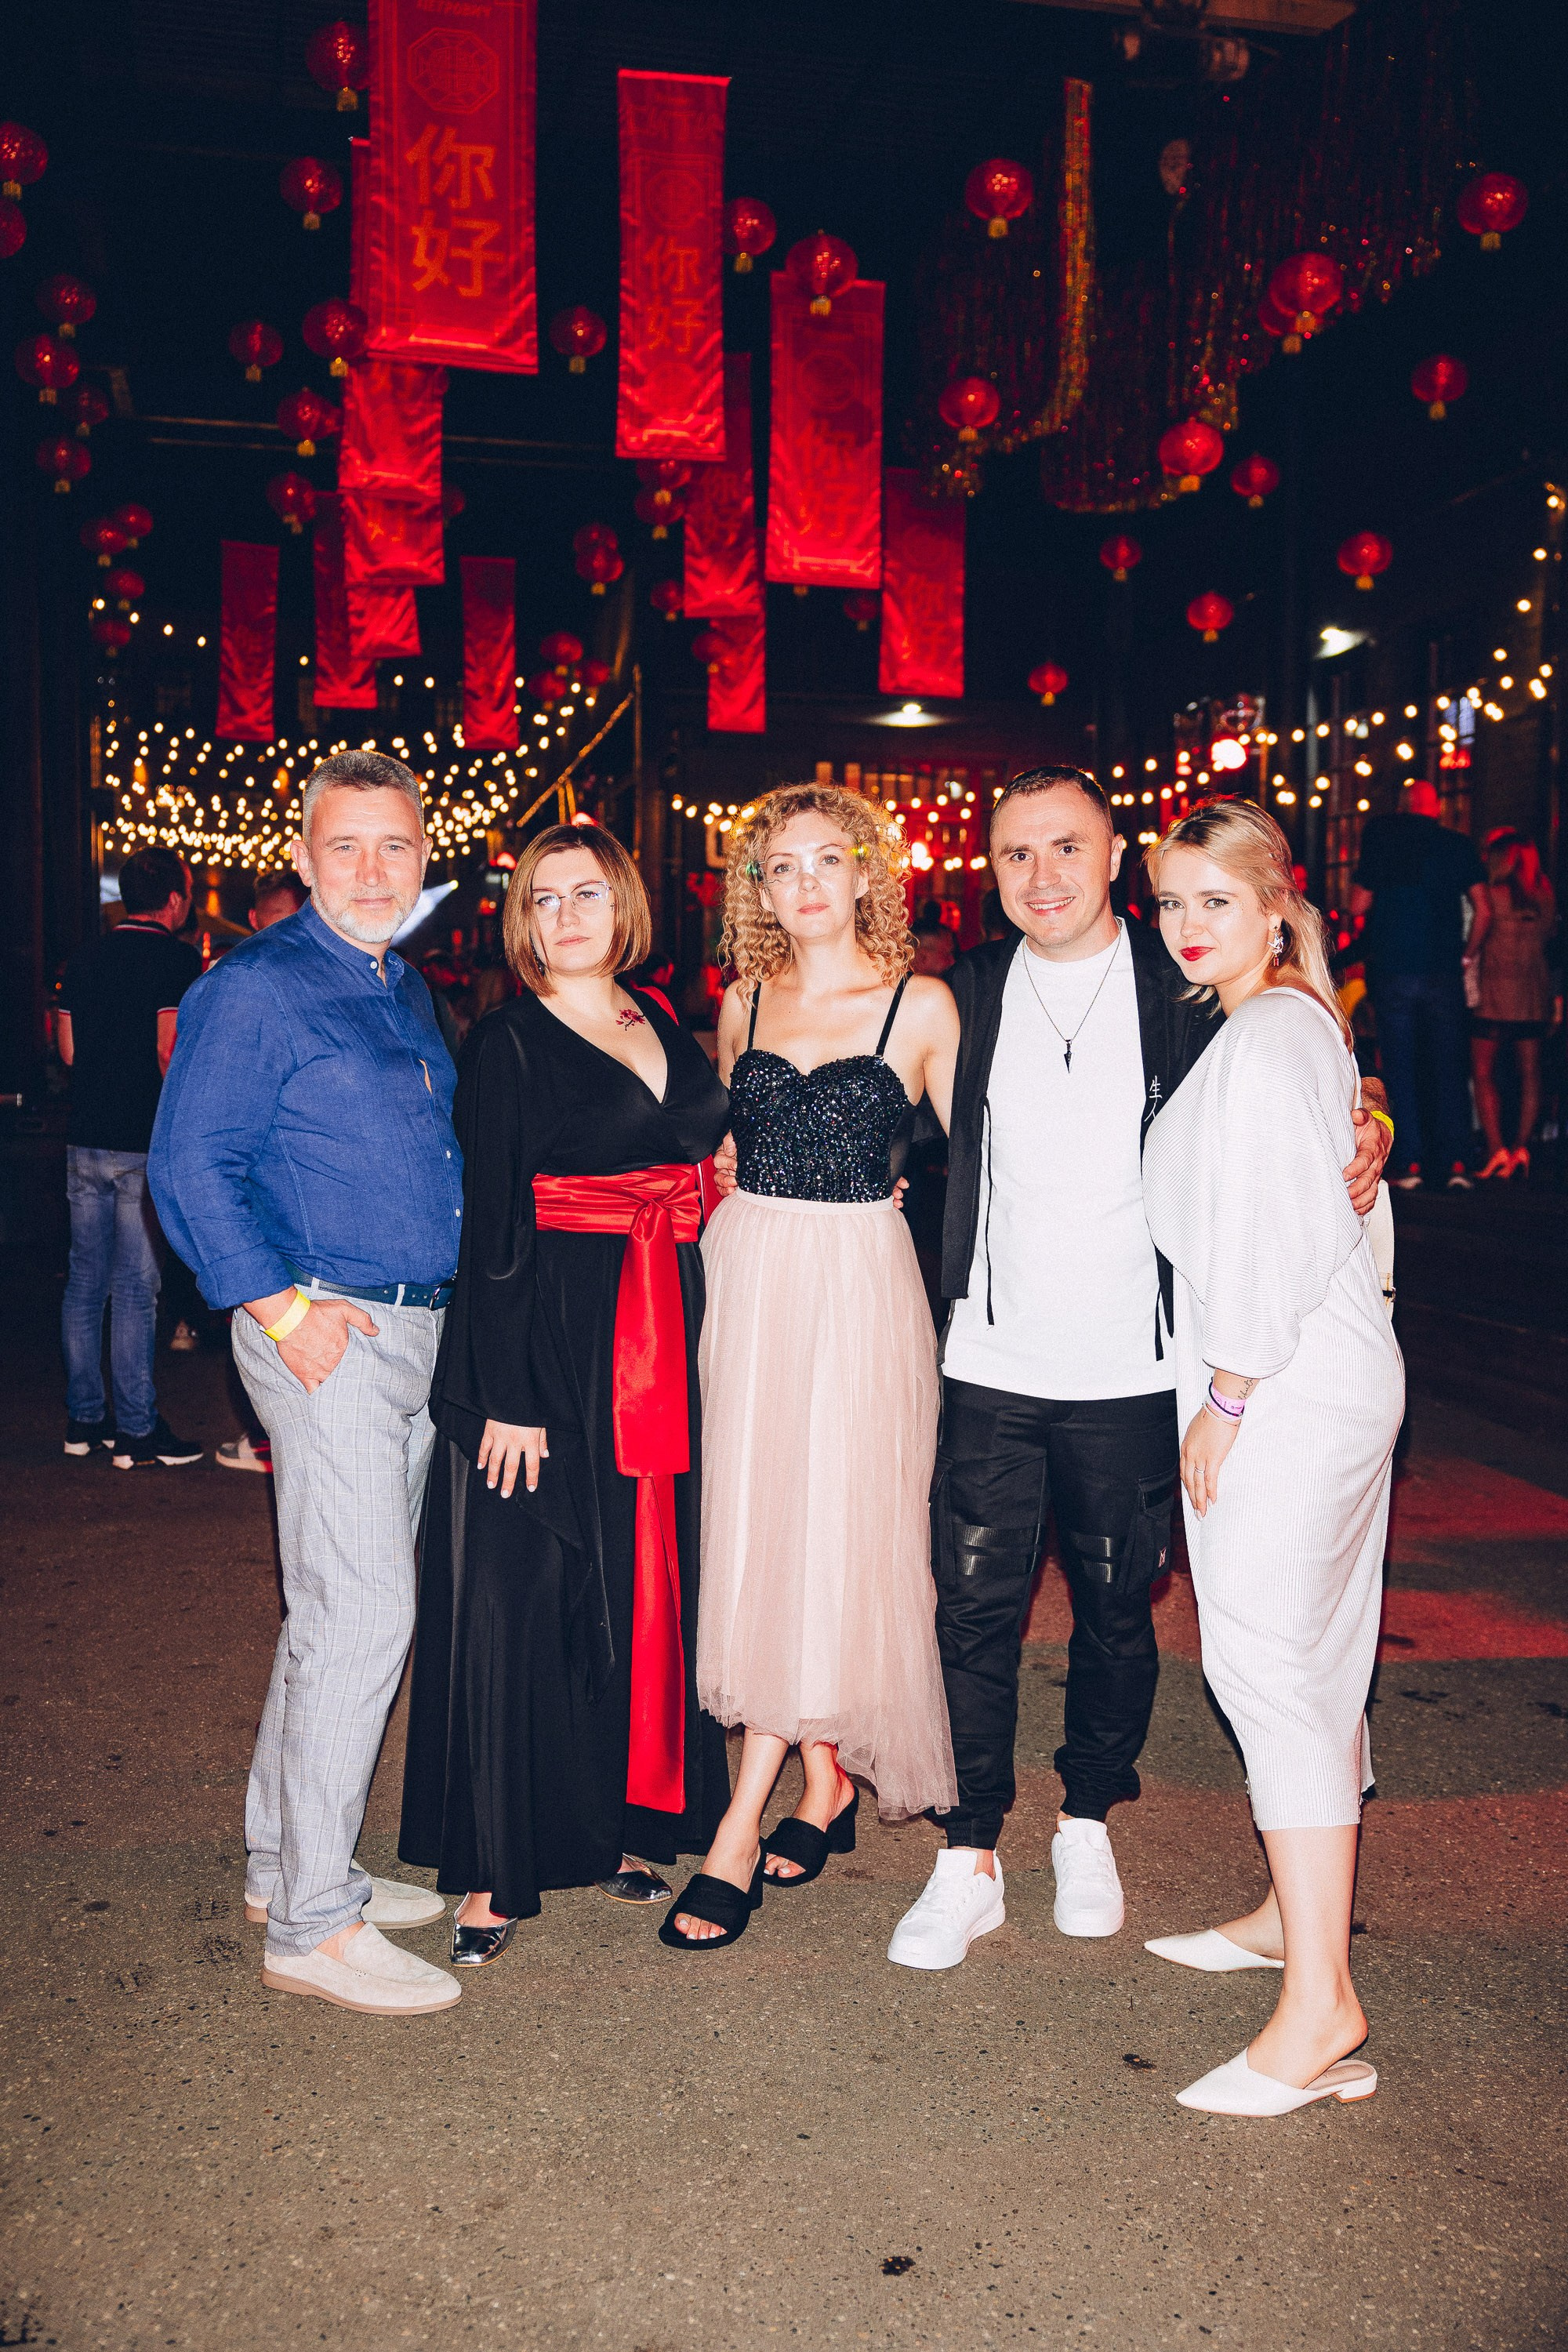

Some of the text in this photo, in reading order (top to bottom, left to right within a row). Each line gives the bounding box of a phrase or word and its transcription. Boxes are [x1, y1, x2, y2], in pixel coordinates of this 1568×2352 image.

[405, 122, 506, 299] 你好
[644, 236, 706, 354] 你好
[795, 417, 861, 539] 你好
